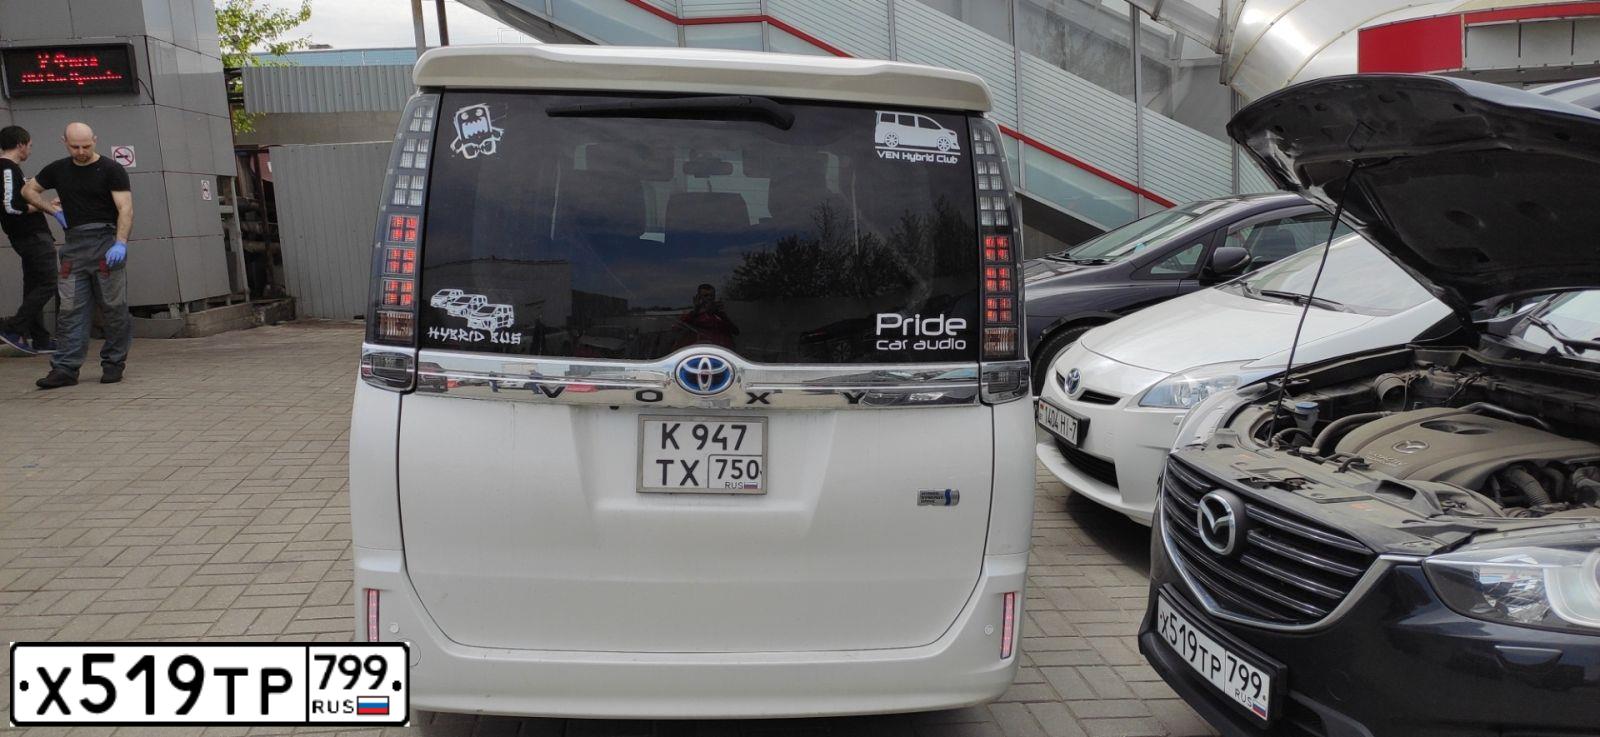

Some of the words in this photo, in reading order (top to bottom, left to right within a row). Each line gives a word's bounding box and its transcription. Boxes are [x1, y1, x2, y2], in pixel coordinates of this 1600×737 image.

[877, 150, 900, 160] VEN
[902, 152, 934, 163] Hybrid
[936, 155, 958, 164] Club
[875, 312, 967, 336] Pride
[427, 326, 485, 342] HYBRID
[876, 340, 906, 350] car
[913, 337, 967, 351] audio
[692, 424, 747, 451] 947
[715, 459, 760, 480] 750
[724, 481, 744, 490] RUS
[1227, 655, 1262, 699] 799
